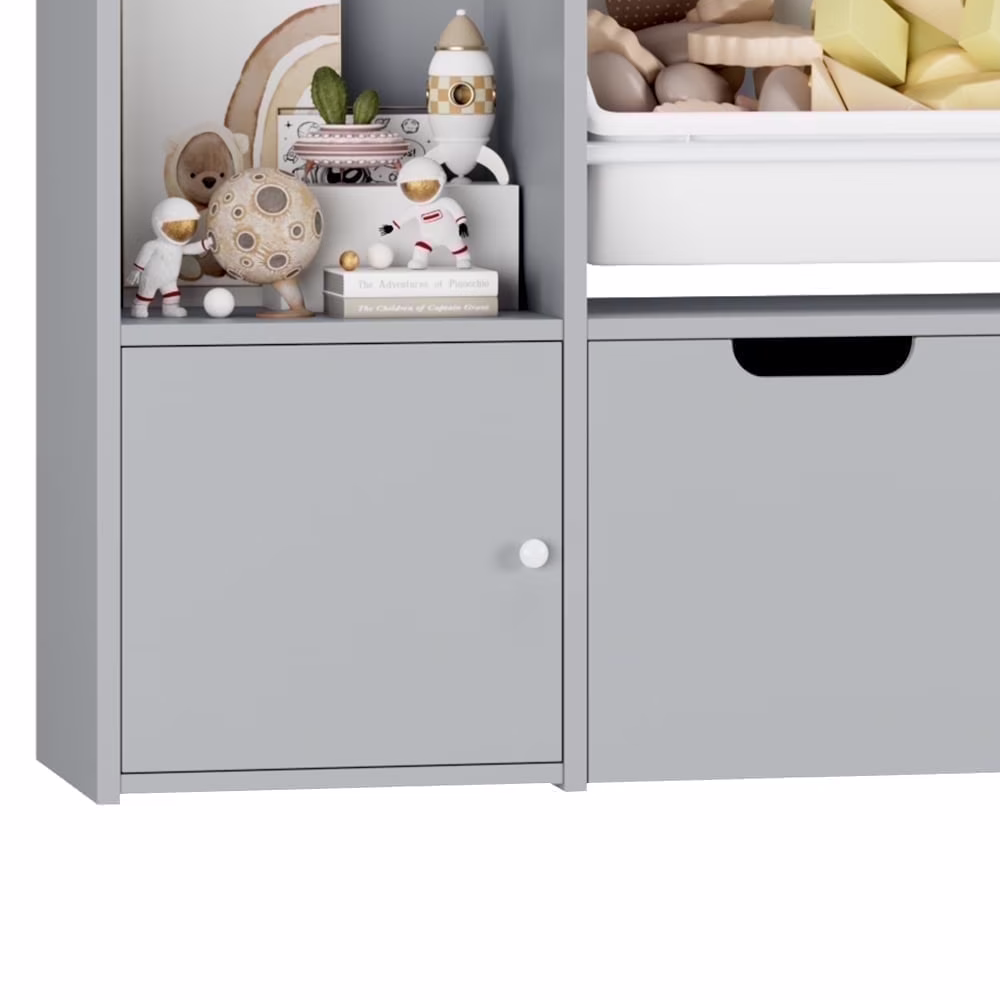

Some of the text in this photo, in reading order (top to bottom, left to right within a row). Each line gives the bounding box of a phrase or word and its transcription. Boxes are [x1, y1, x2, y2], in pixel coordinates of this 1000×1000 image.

[358, 279, 490, 289] The Adventures of Pinocchio
[357, 303, 490, 313] The Children of Captain Grant
